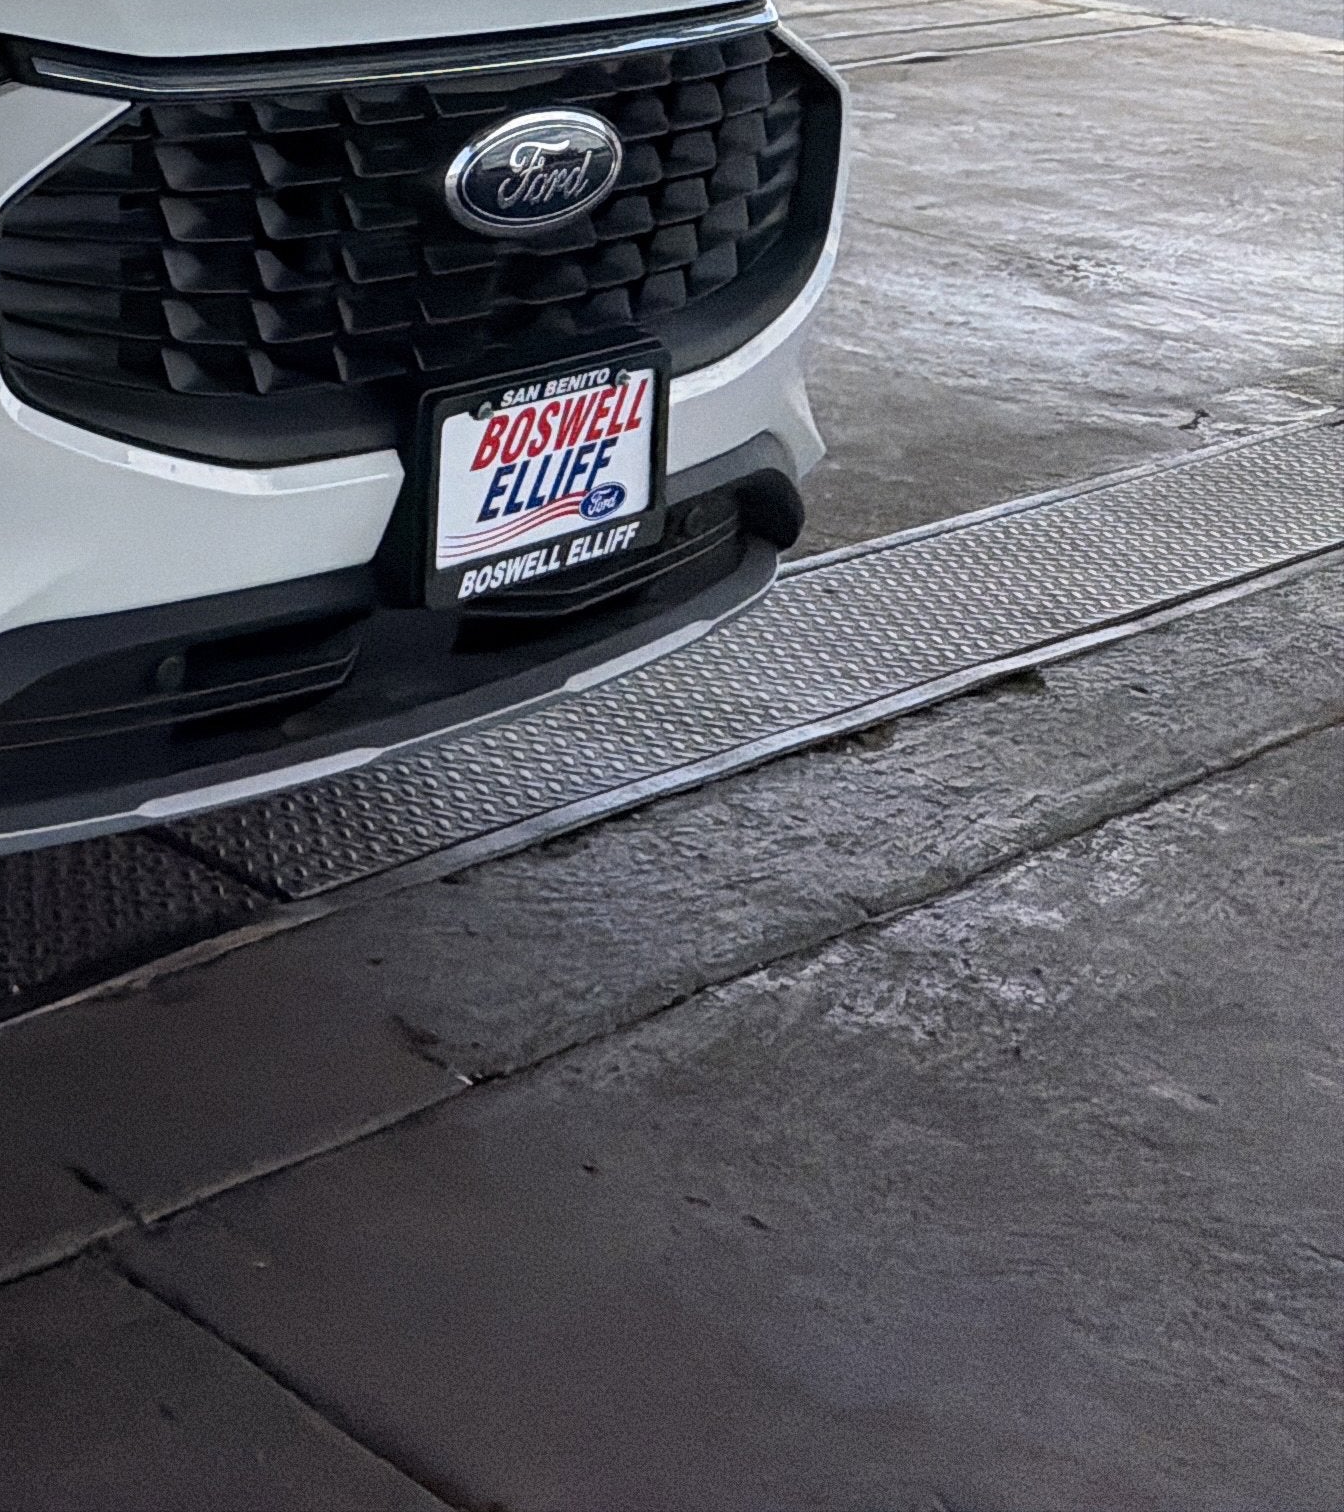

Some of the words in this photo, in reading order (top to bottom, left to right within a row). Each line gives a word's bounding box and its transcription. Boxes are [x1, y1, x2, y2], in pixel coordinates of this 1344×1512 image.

[497, 140, 593, 209] Ford
[500, 383, 538, 408] SAN
[543, 367, 611, 397] BENITO
[470, 377, 649, 472] BOSWELL
[476, 436, 619, 523] ELLIFF
[588, 488, 618, 516] Ford
[457, 544, 561, 599] BOSWELL
[565, 521, 641, 567] ELLIFF
